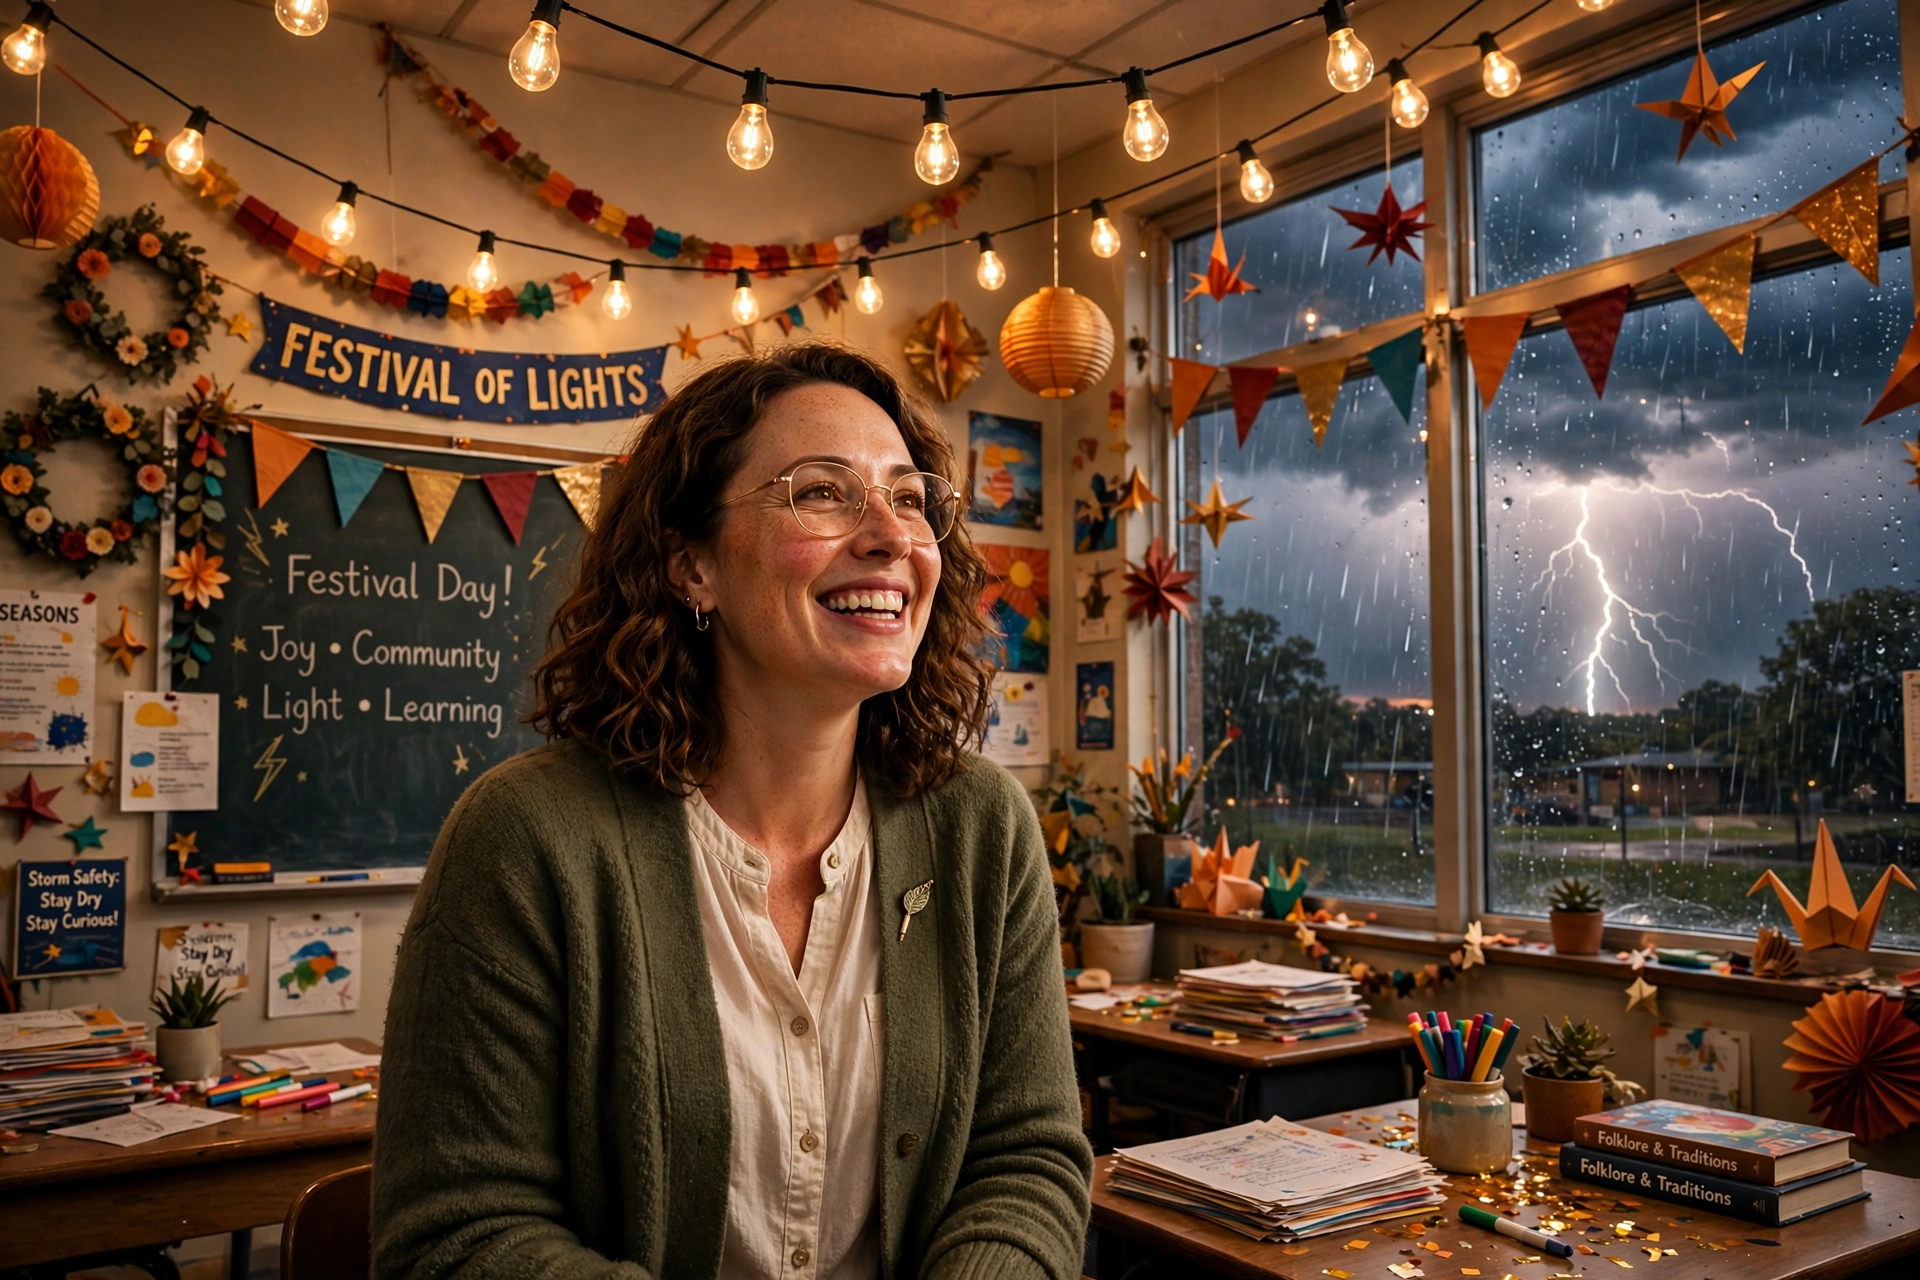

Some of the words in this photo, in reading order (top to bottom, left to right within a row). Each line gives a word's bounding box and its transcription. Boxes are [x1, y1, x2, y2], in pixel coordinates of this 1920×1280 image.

[280, 322, 460, 405] FESTIVAL
[474, 367, 514, 404] OF
[527, 364, 649, 411] LIGHTS
[287, 554, 419, 599] Festival
[437, 562, 512, 619] Day!
[0, 603, 79, 624] SEASONS
[259, 625, 316, 677] Joy
[352, 629, 501, 683] Community
[263, 684, 343, 735] Light
[384, 687, 502, 739] Learning
[28, 870, 70, 887] Storm
[73, 868, 120, 888] Safety:
[40, 892, 73, 912] Stay
[77, 890, 102, 910] Dry
[26, 914, 58, 935] Stay
[62, 910, 119, 929] Curious!
[181, 947, 208, 964] Stay
[213, 945, 233, 963] Dry
[1598, 1130, 1649, 1153] Folklore
[1653, 1141, 1664, 1155] &
[1669, 1144, 1738, 1172] Traditions
[1580, 1158, 1635, 1184] Folklore
[1640, 1171, 1651, 1187] &
[1657, 1175, 1731, 1206] Traditions
